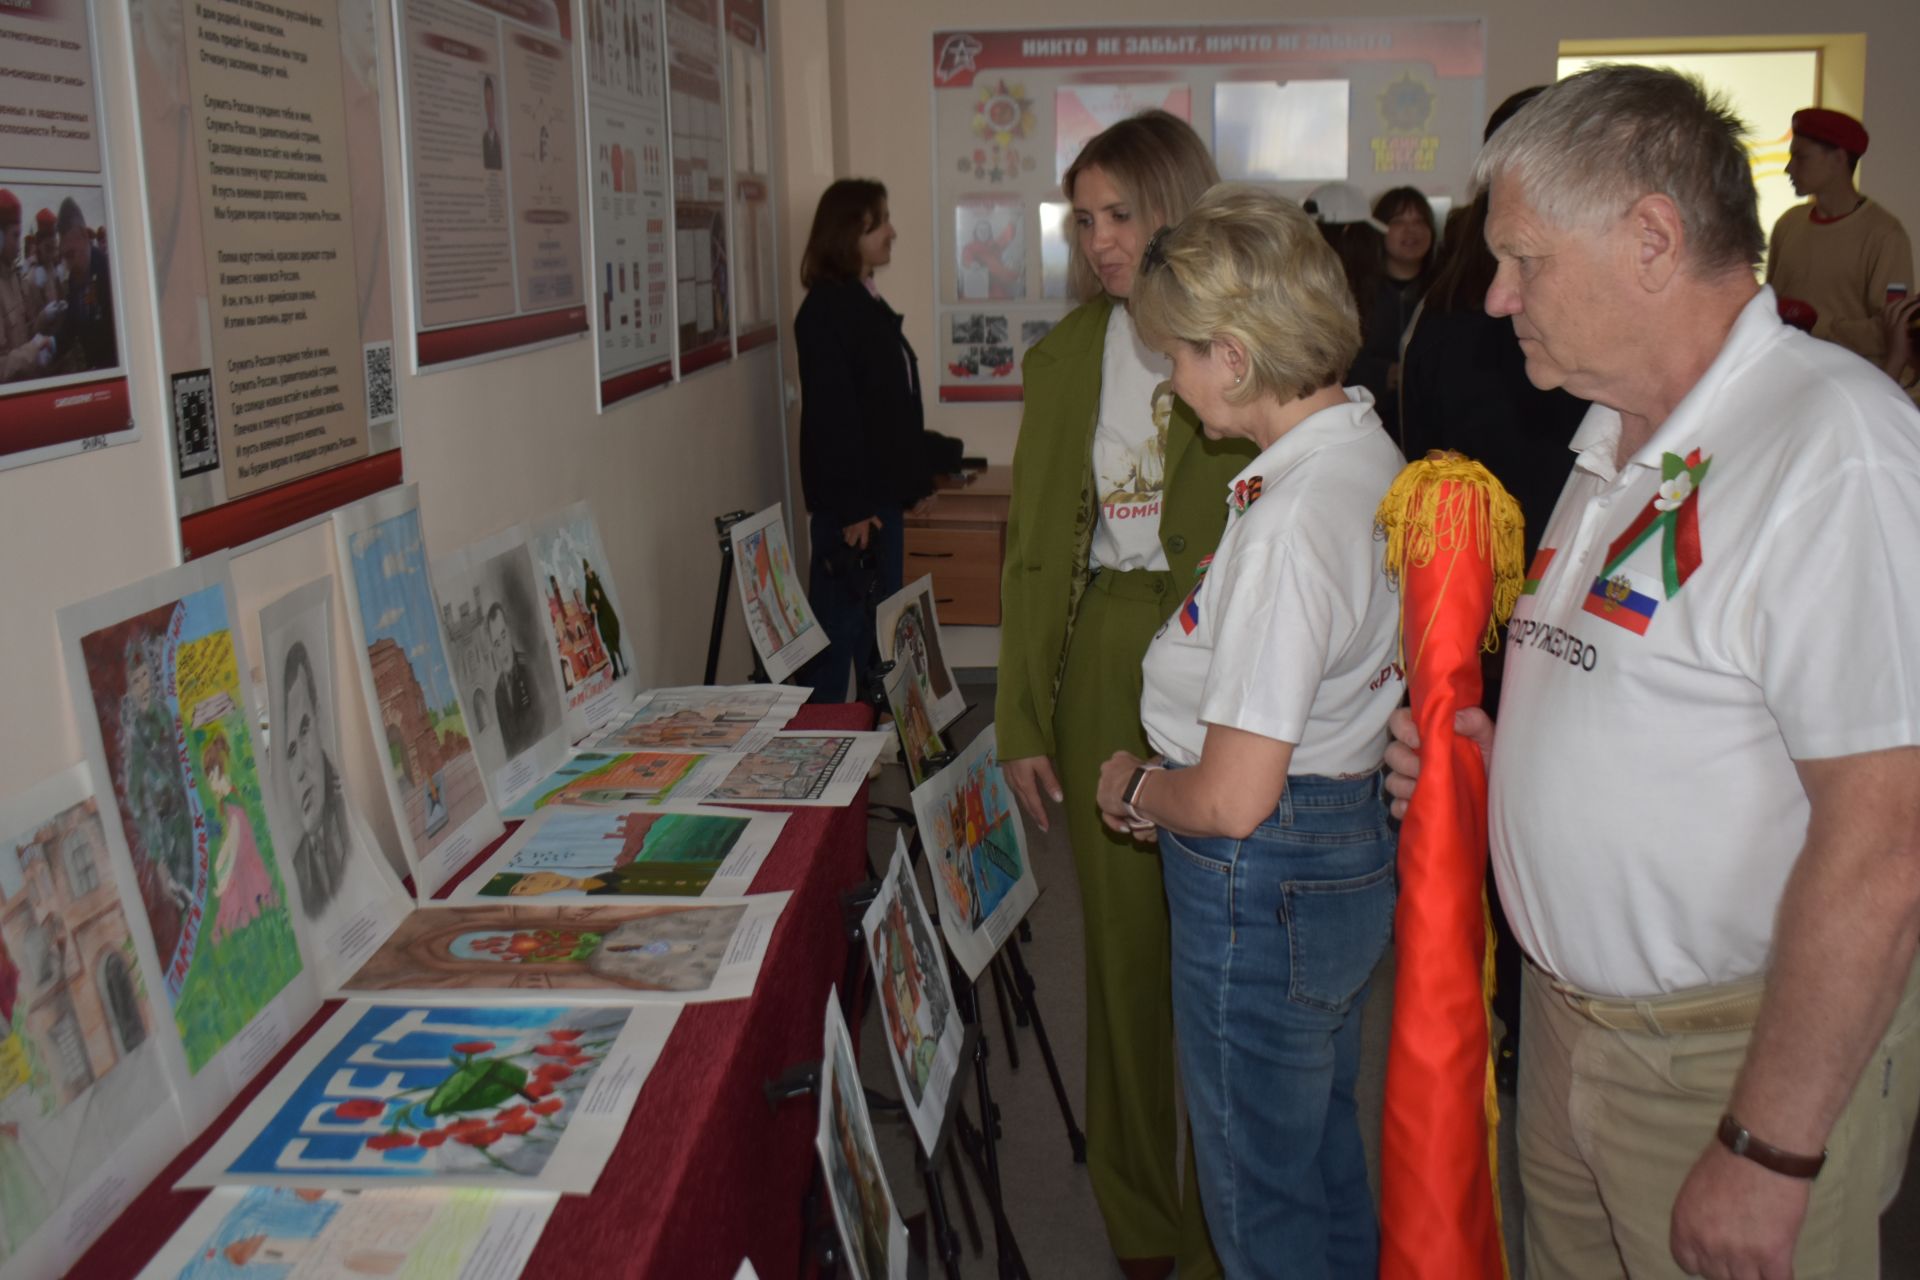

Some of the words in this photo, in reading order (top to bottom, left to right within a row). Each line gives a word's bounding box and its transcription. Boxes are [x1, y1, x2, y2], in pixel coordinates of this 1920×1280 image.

[1022, 39, 1087, 56] НИКТО
[1097, 37, 1121, 55] НЕ
[1125, 36, 1200, 55] ЗАБЫТ,
[1206, 35, 1272, 53] НИЧТО
[1277, 35, 1299, 51] НЕ
